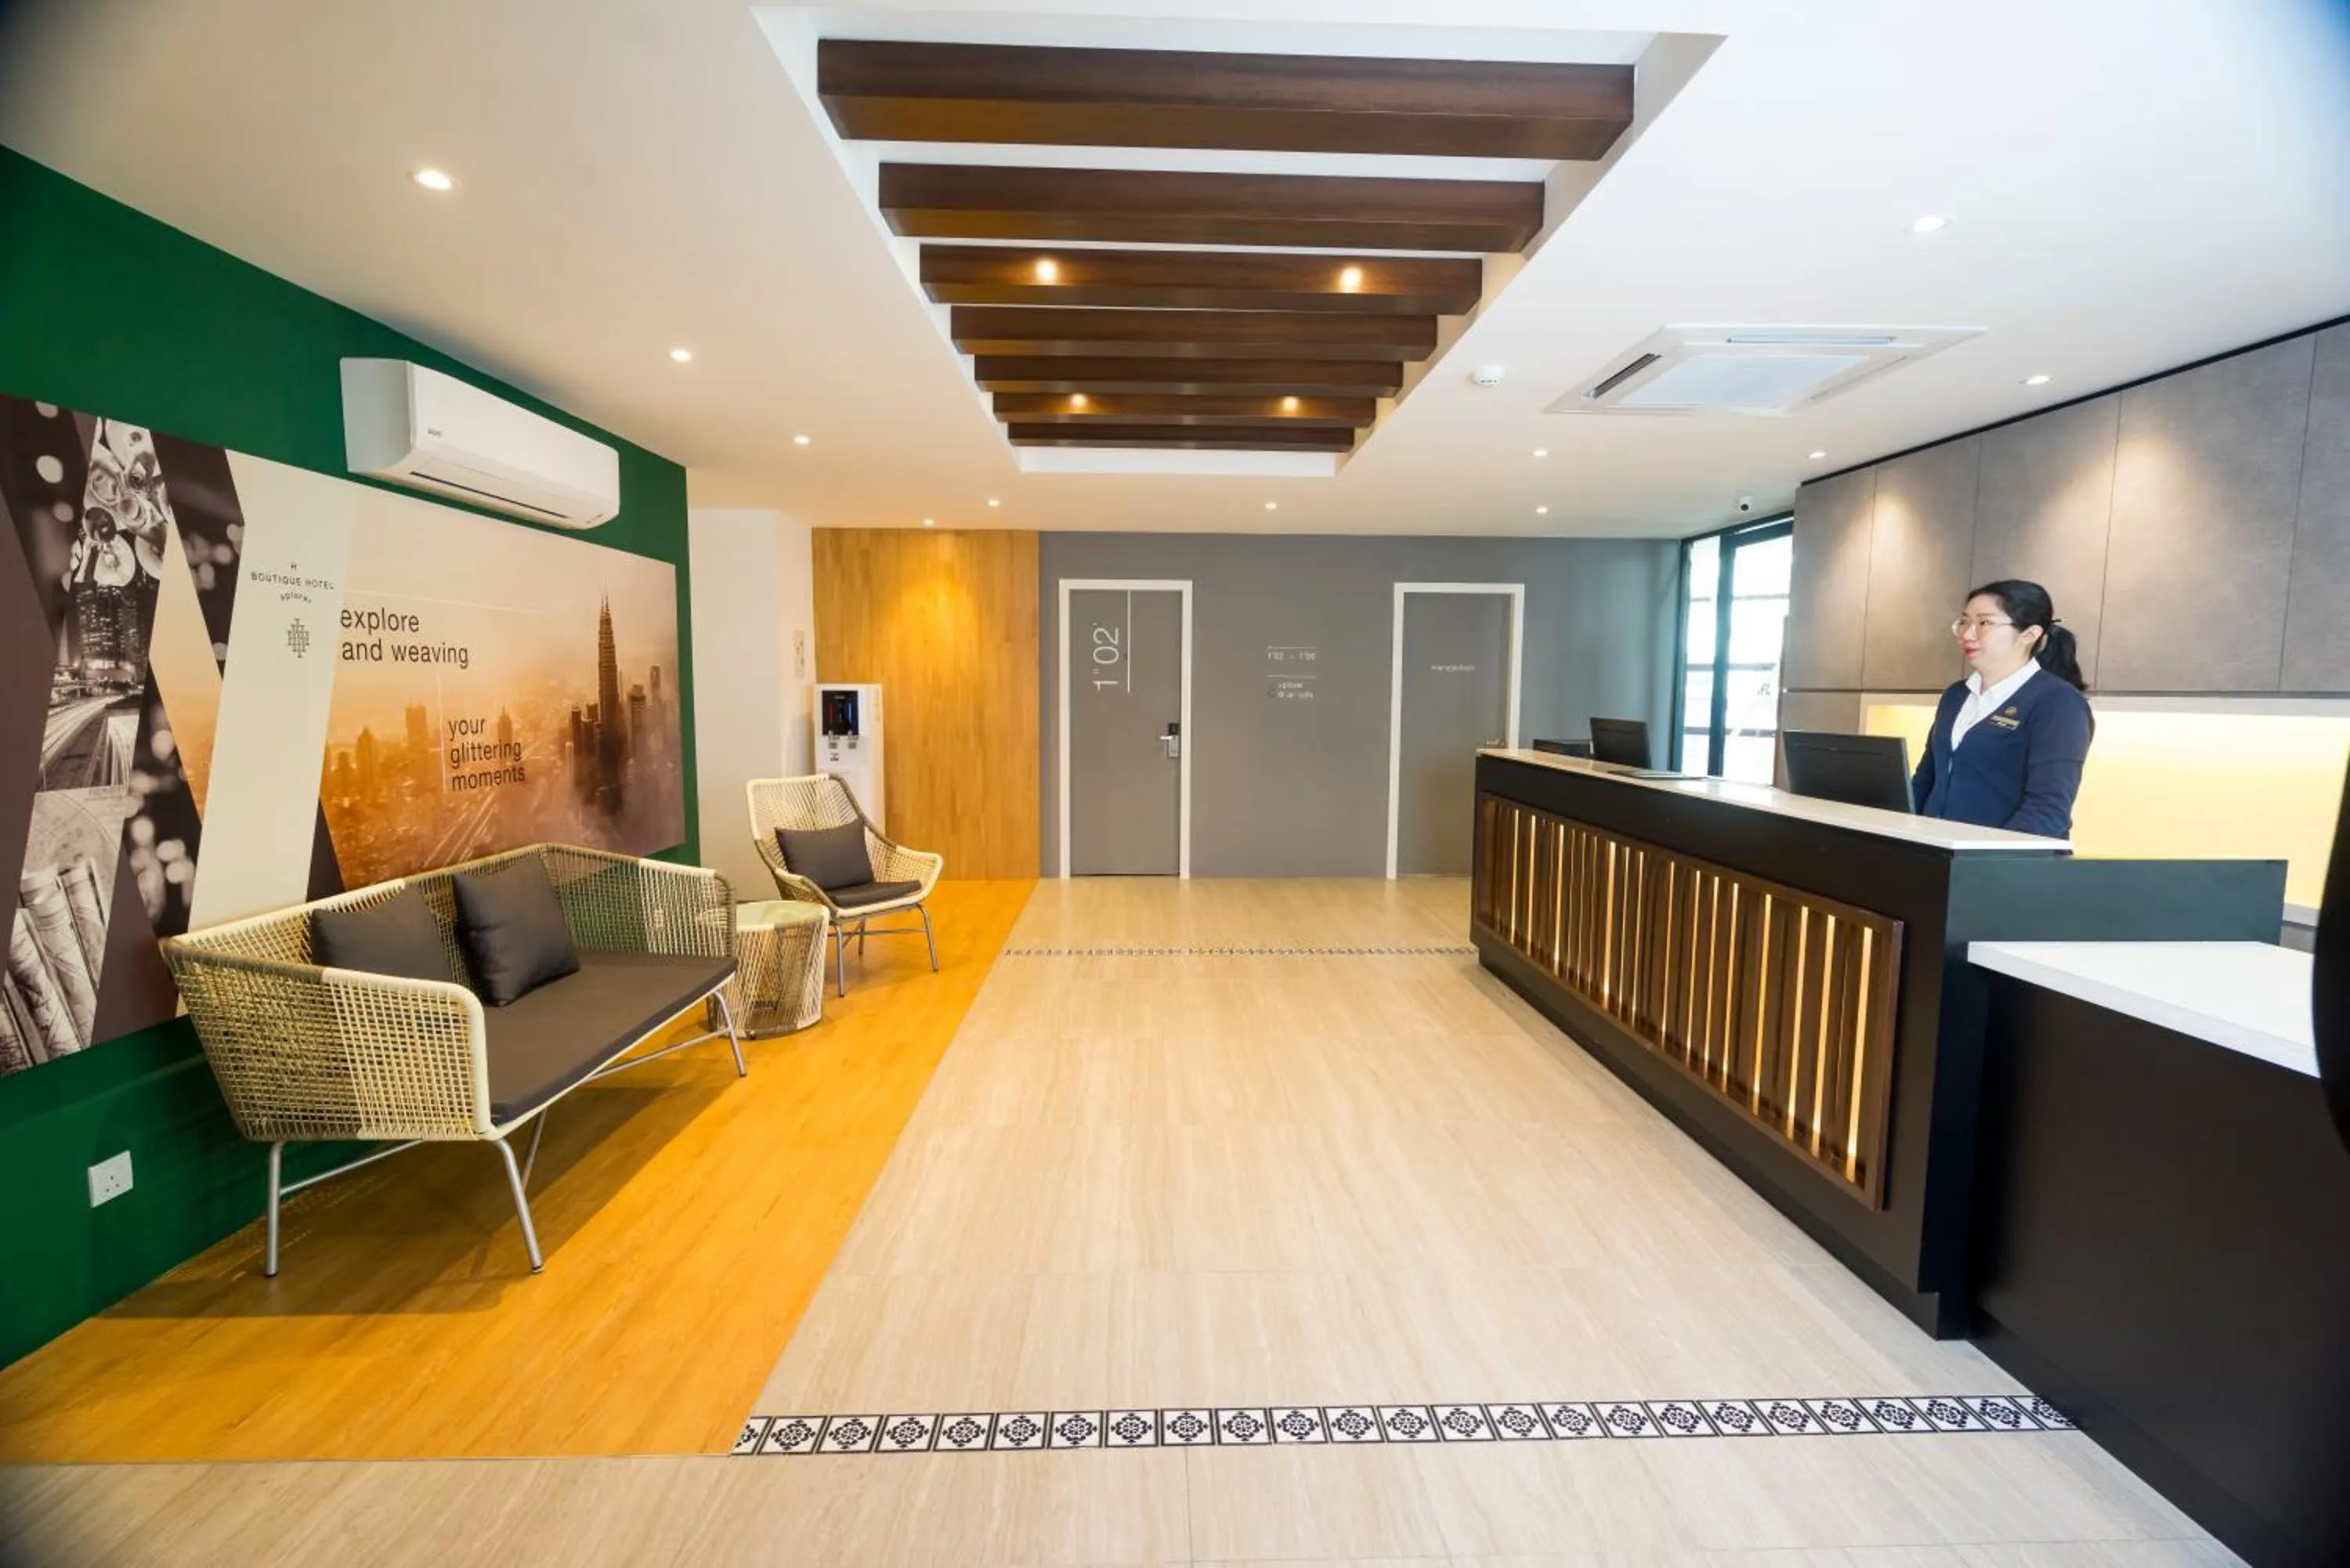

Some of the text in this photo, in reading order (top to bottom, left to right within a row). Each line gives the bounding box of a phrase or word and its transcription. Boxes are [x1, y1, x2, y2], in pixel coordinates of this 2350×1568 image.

[251, 572, 334, 590] BOUTIQUE HOTEL
[341, 607, 420, 635] explore
[342, 638, 469, 669] and weaving
[448, 717, 486, 741] your
[450, 739, 522, 768] glittering
[452, 766, 526, 791] moments
